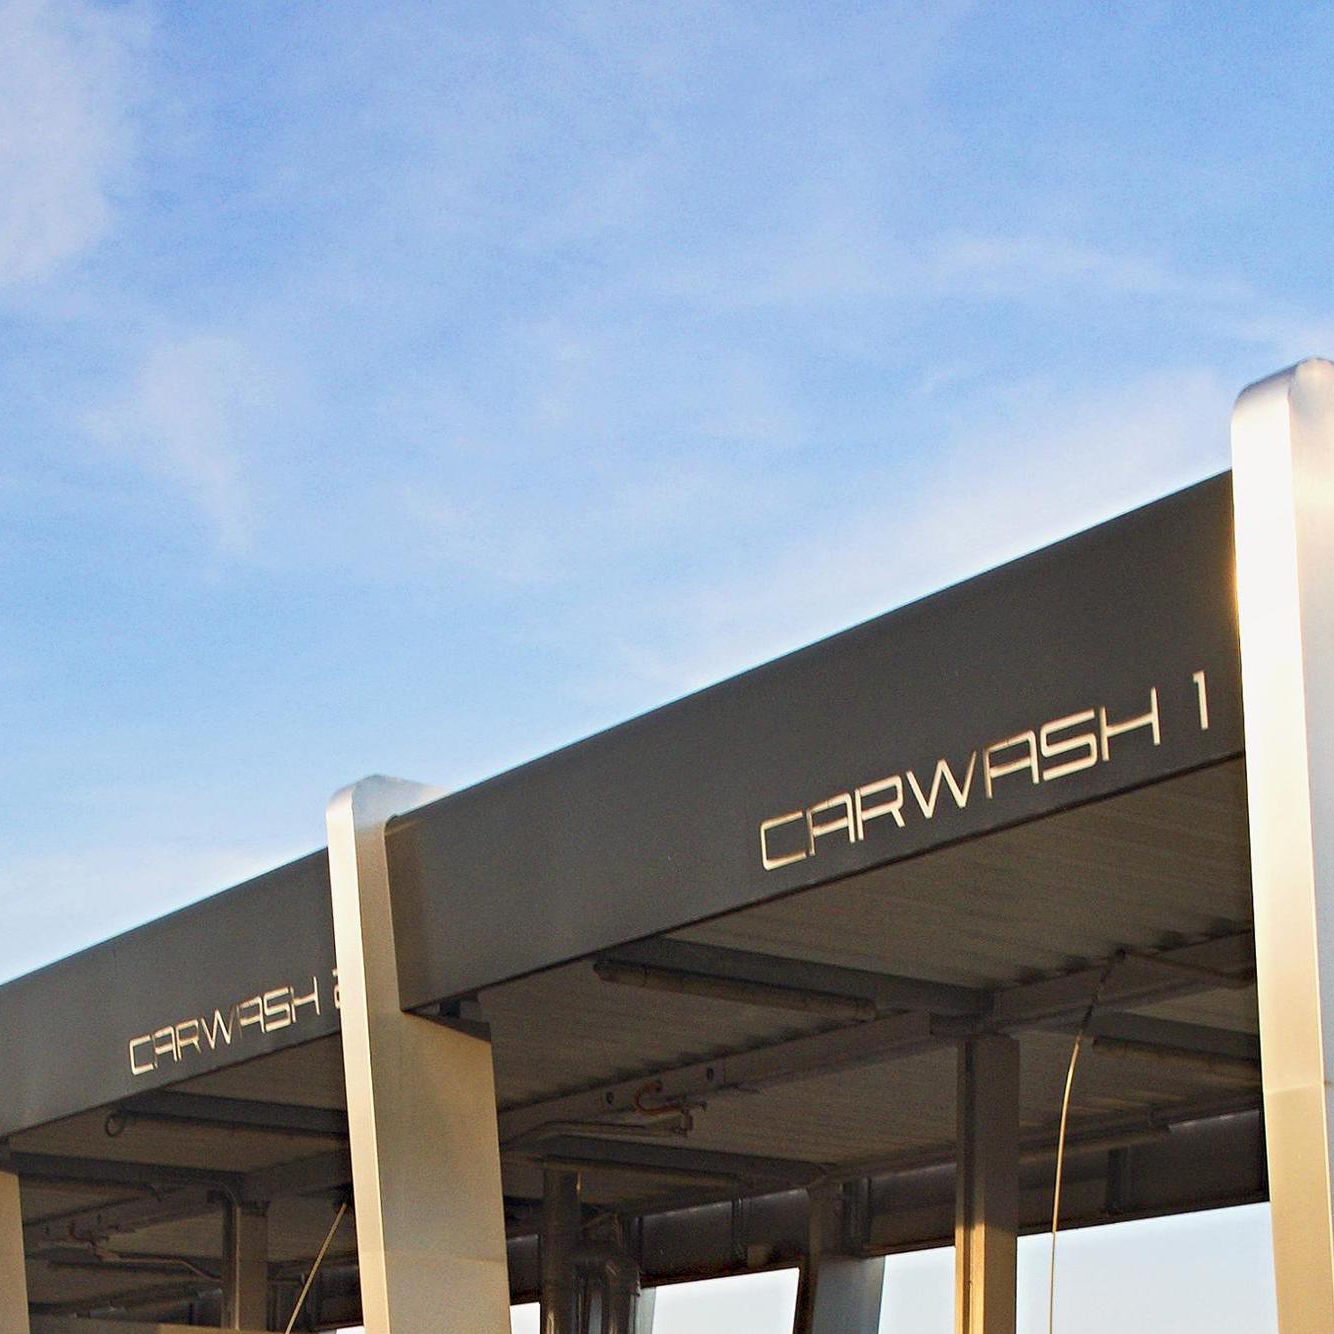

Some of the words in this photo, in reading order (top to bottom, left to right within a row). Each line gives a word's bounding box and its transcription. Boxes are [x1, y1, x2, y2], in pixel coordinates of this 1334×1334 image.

[760, 686, 1161, 871] CARWASH
[1192, 669, 1209, 731] 1
[129, 975, 321, 1076] CARWASH
